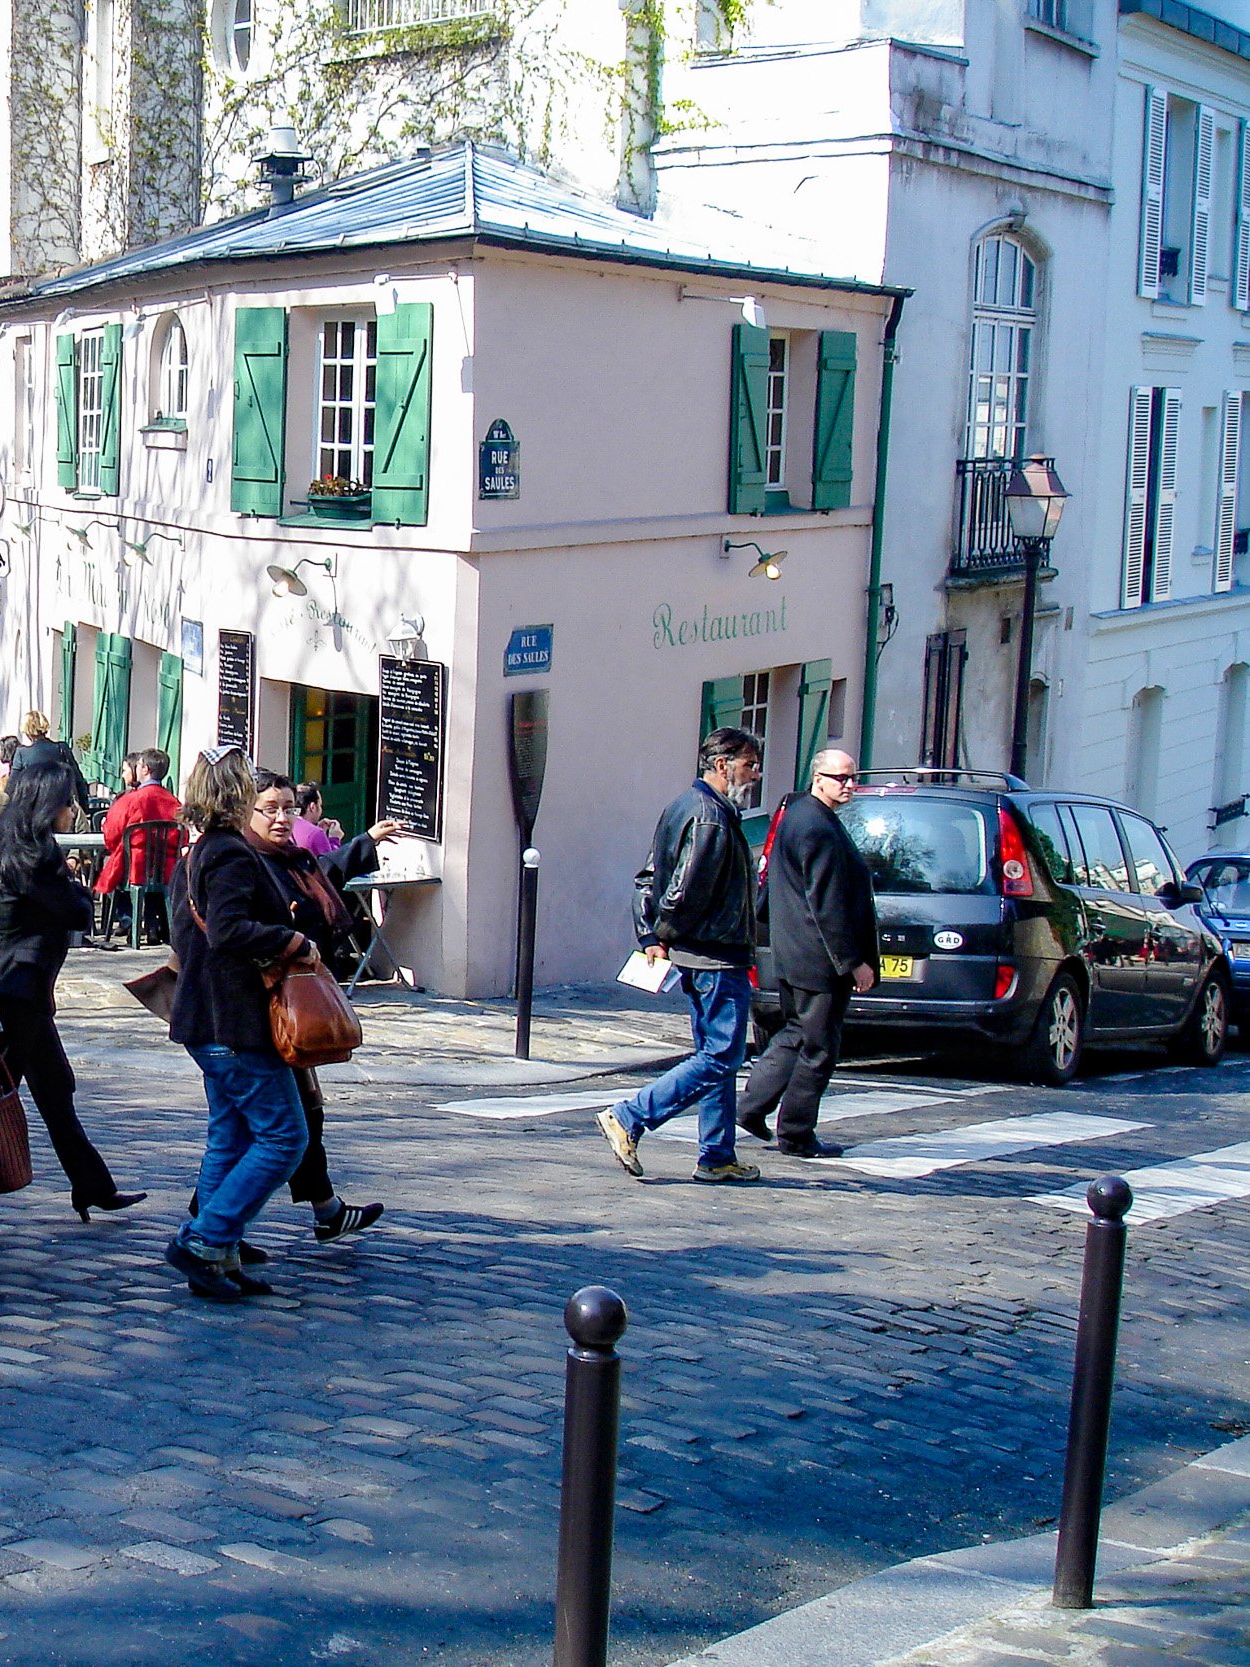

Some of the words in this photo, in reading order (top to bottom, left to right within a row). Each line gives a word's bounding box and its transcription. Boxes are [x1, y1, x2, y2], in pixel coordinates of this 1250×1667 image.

[491, 451, 508, 464] RUE
[485, 477, 515, 490] SAULES
[653, 596, 787, 650] Restaurant
[521, 635, 537, 647] RUE
[508, 653, 522, 665] DES
[523, 650, 549, 663] SAULES
[892, 958, 908, 972] 75
